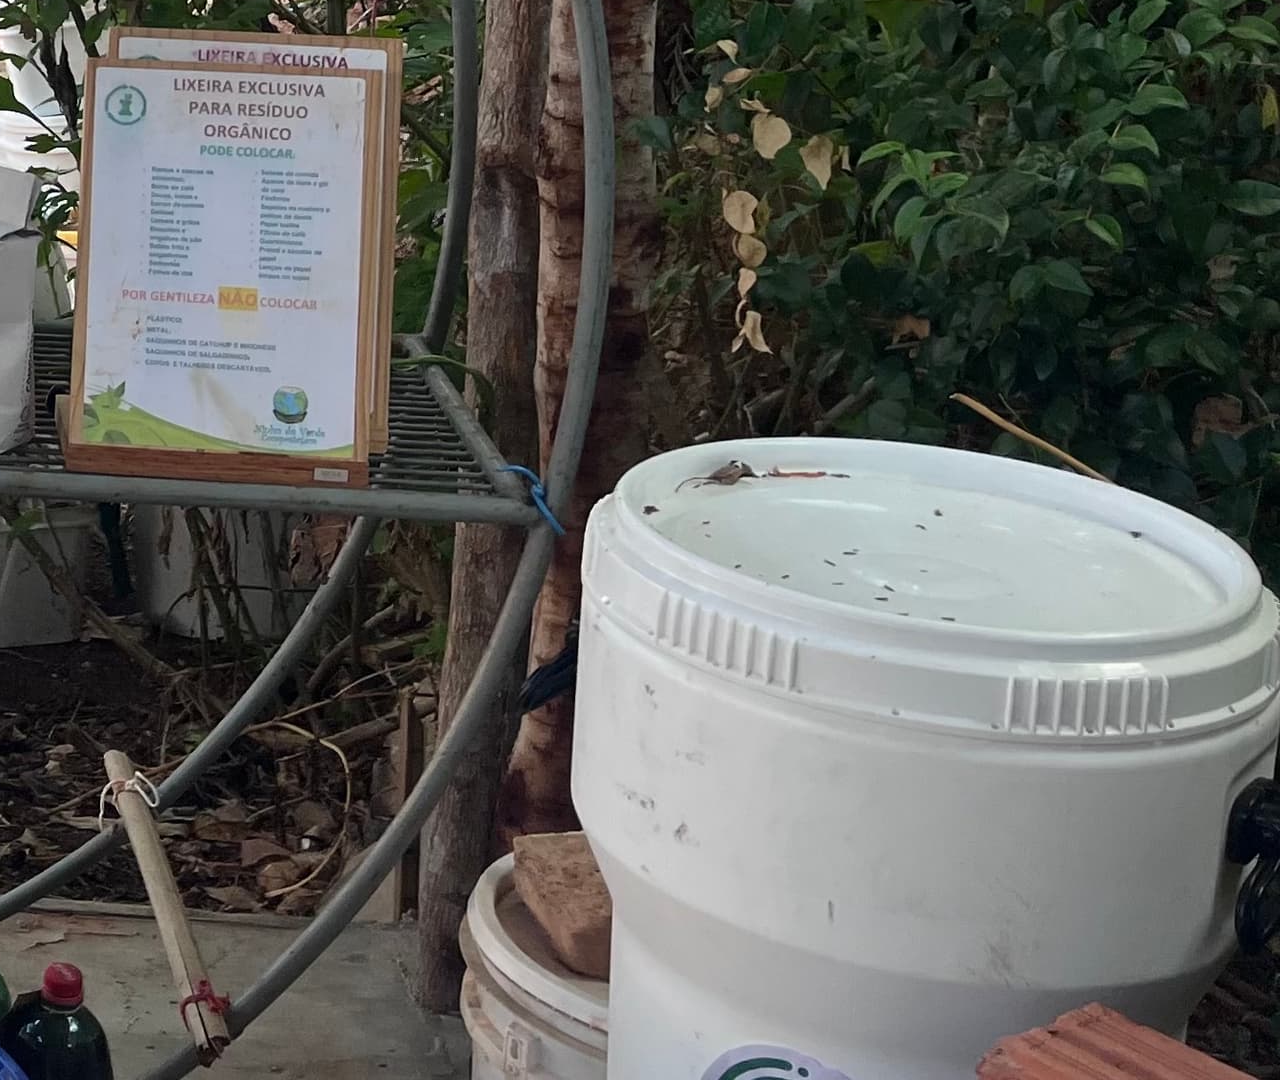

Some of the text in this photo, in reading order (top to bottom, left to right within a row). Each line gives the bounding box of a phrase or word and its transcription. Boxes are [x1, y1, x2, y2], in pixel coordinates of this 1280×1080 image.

[263, 52, 349, 69] EXCLUSIVA
[174, 78, 326, 97] LIXEIRA EXCLUSIVA
[189, 101, 309, 119] PARA RESÍDUO
[204, 123, 292, 141] ORGÂNICO
[200, 145, 233, 157] PODE
[122, 287, 318, 310] POR GENTILEZA NÃO COLOCAR
